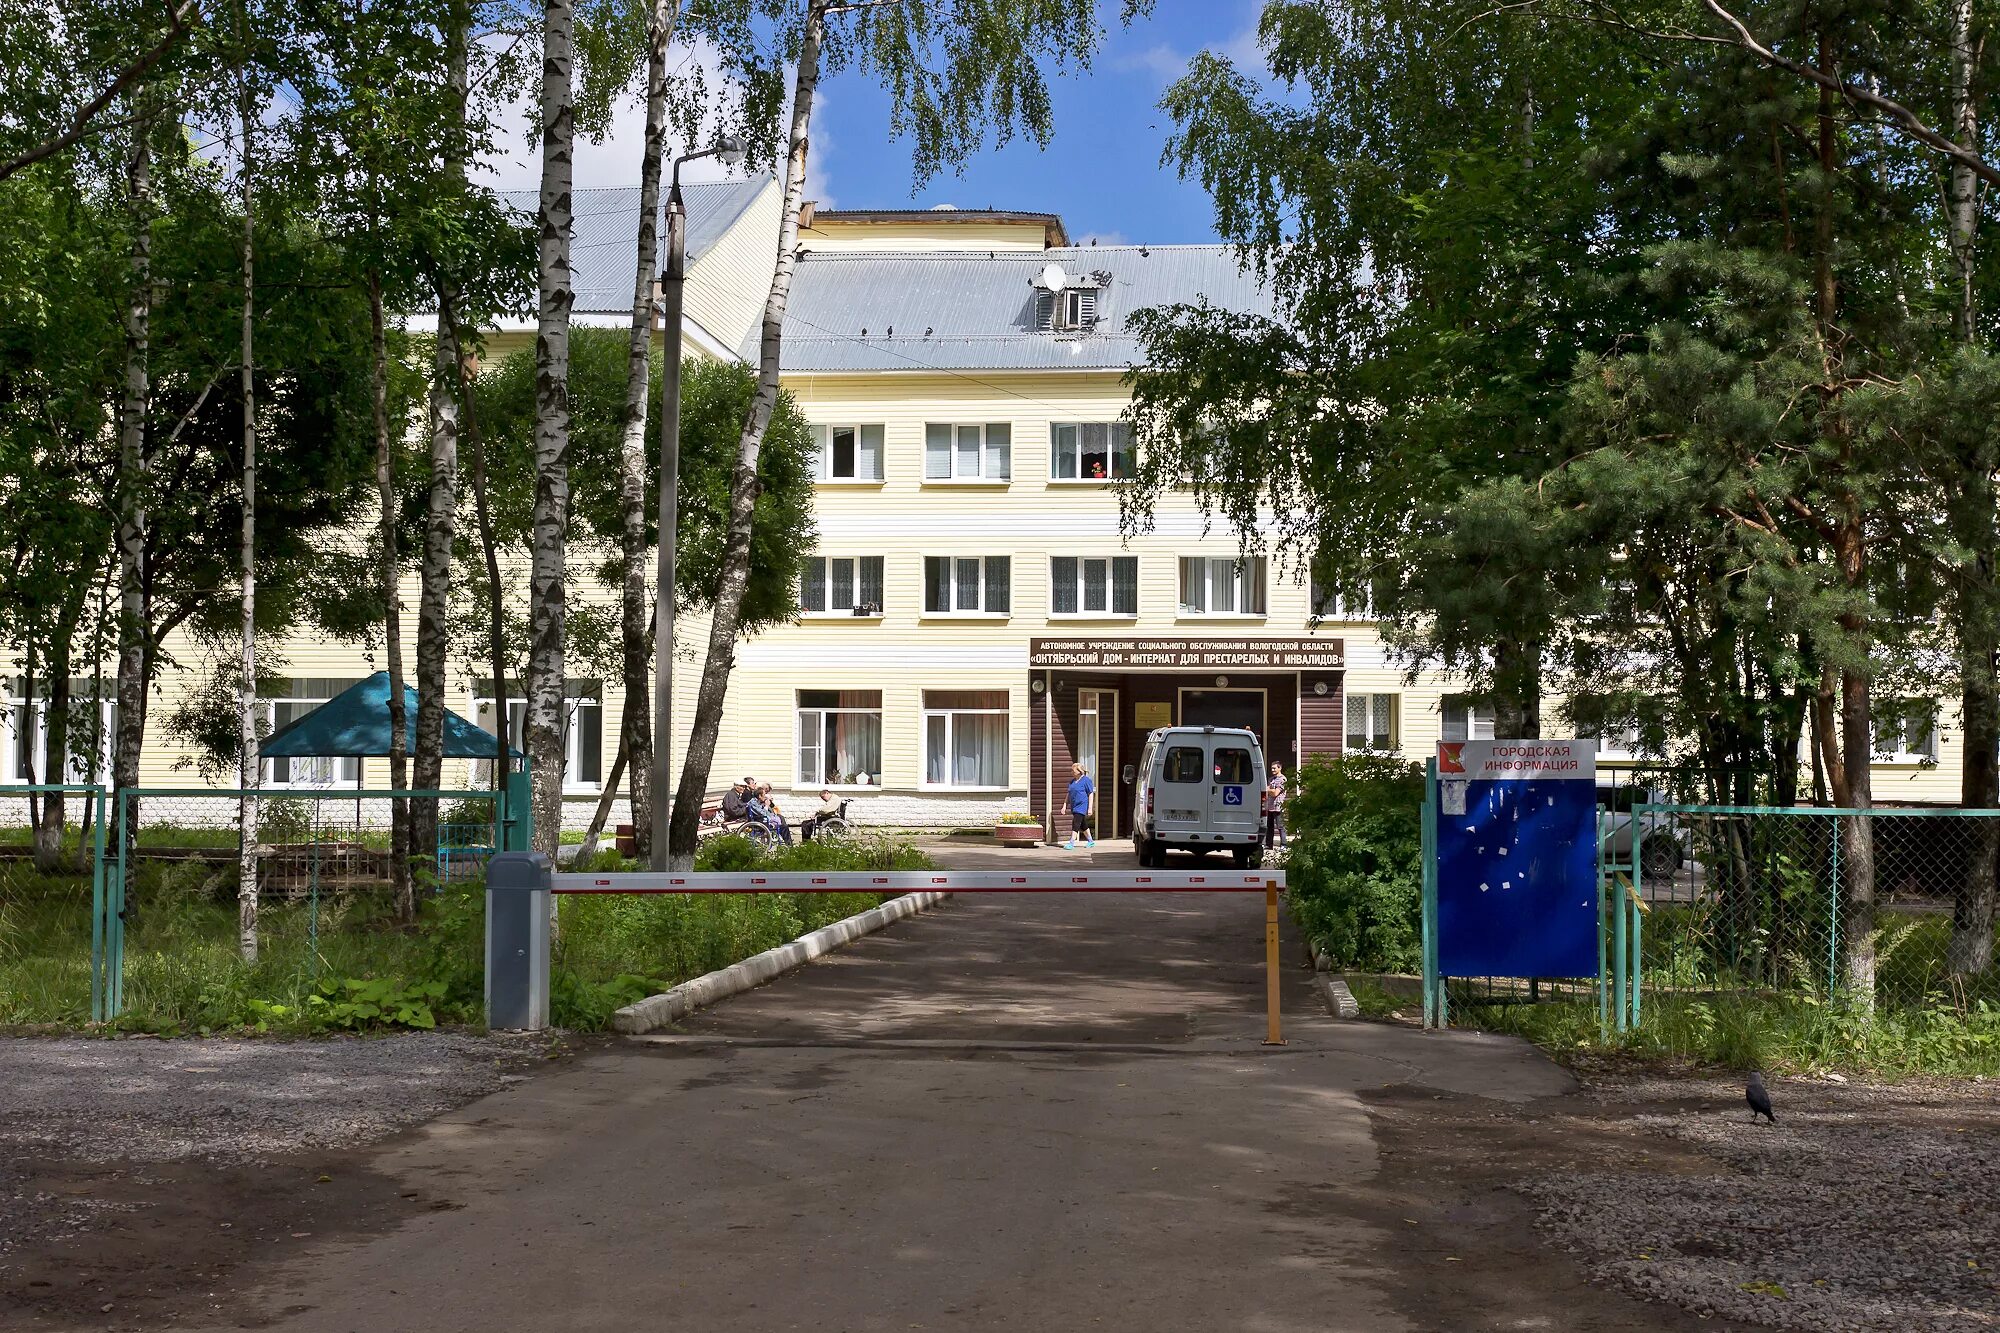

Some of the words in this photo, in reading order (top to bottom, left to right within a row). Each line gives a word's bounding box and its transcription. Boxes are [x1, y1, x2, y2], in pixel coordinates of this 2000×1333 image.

[1040, 642, 1085, 650] АВТОНОМНОЕ
[1088, 642, 1135, 650] УЧРЕЖДЕНИЕ
[1138, 642, 1187, 650] СОЦИАЛЬНОГО
[1189, 642, 1247, 650] ОБСЛУЖИВАНИЯ
[1249, 642, 1299, 651] ВОЛОГОДСКОЙ
[1301, 643, 1334, 651] ОБЛАСТИ
[1102, 653, 1123, 665] ДОМ
[1130, 653, 1176, 664] ИНТЕРНАТ
[1179, 654, 1200, 665] ДЛЯ
[1203, 654, 1269, 664] ПРЕСТАРЕЛЫХ
[1273, 654, 1280, 664] И
[1284, 654, 1344, 665] ИНВАЛИДОВ»
[1492, 746, 1570, 757] ГОРОДСКАЯ
[1485, 760, 1578, 771] ИНФОРМАЦИЯ
